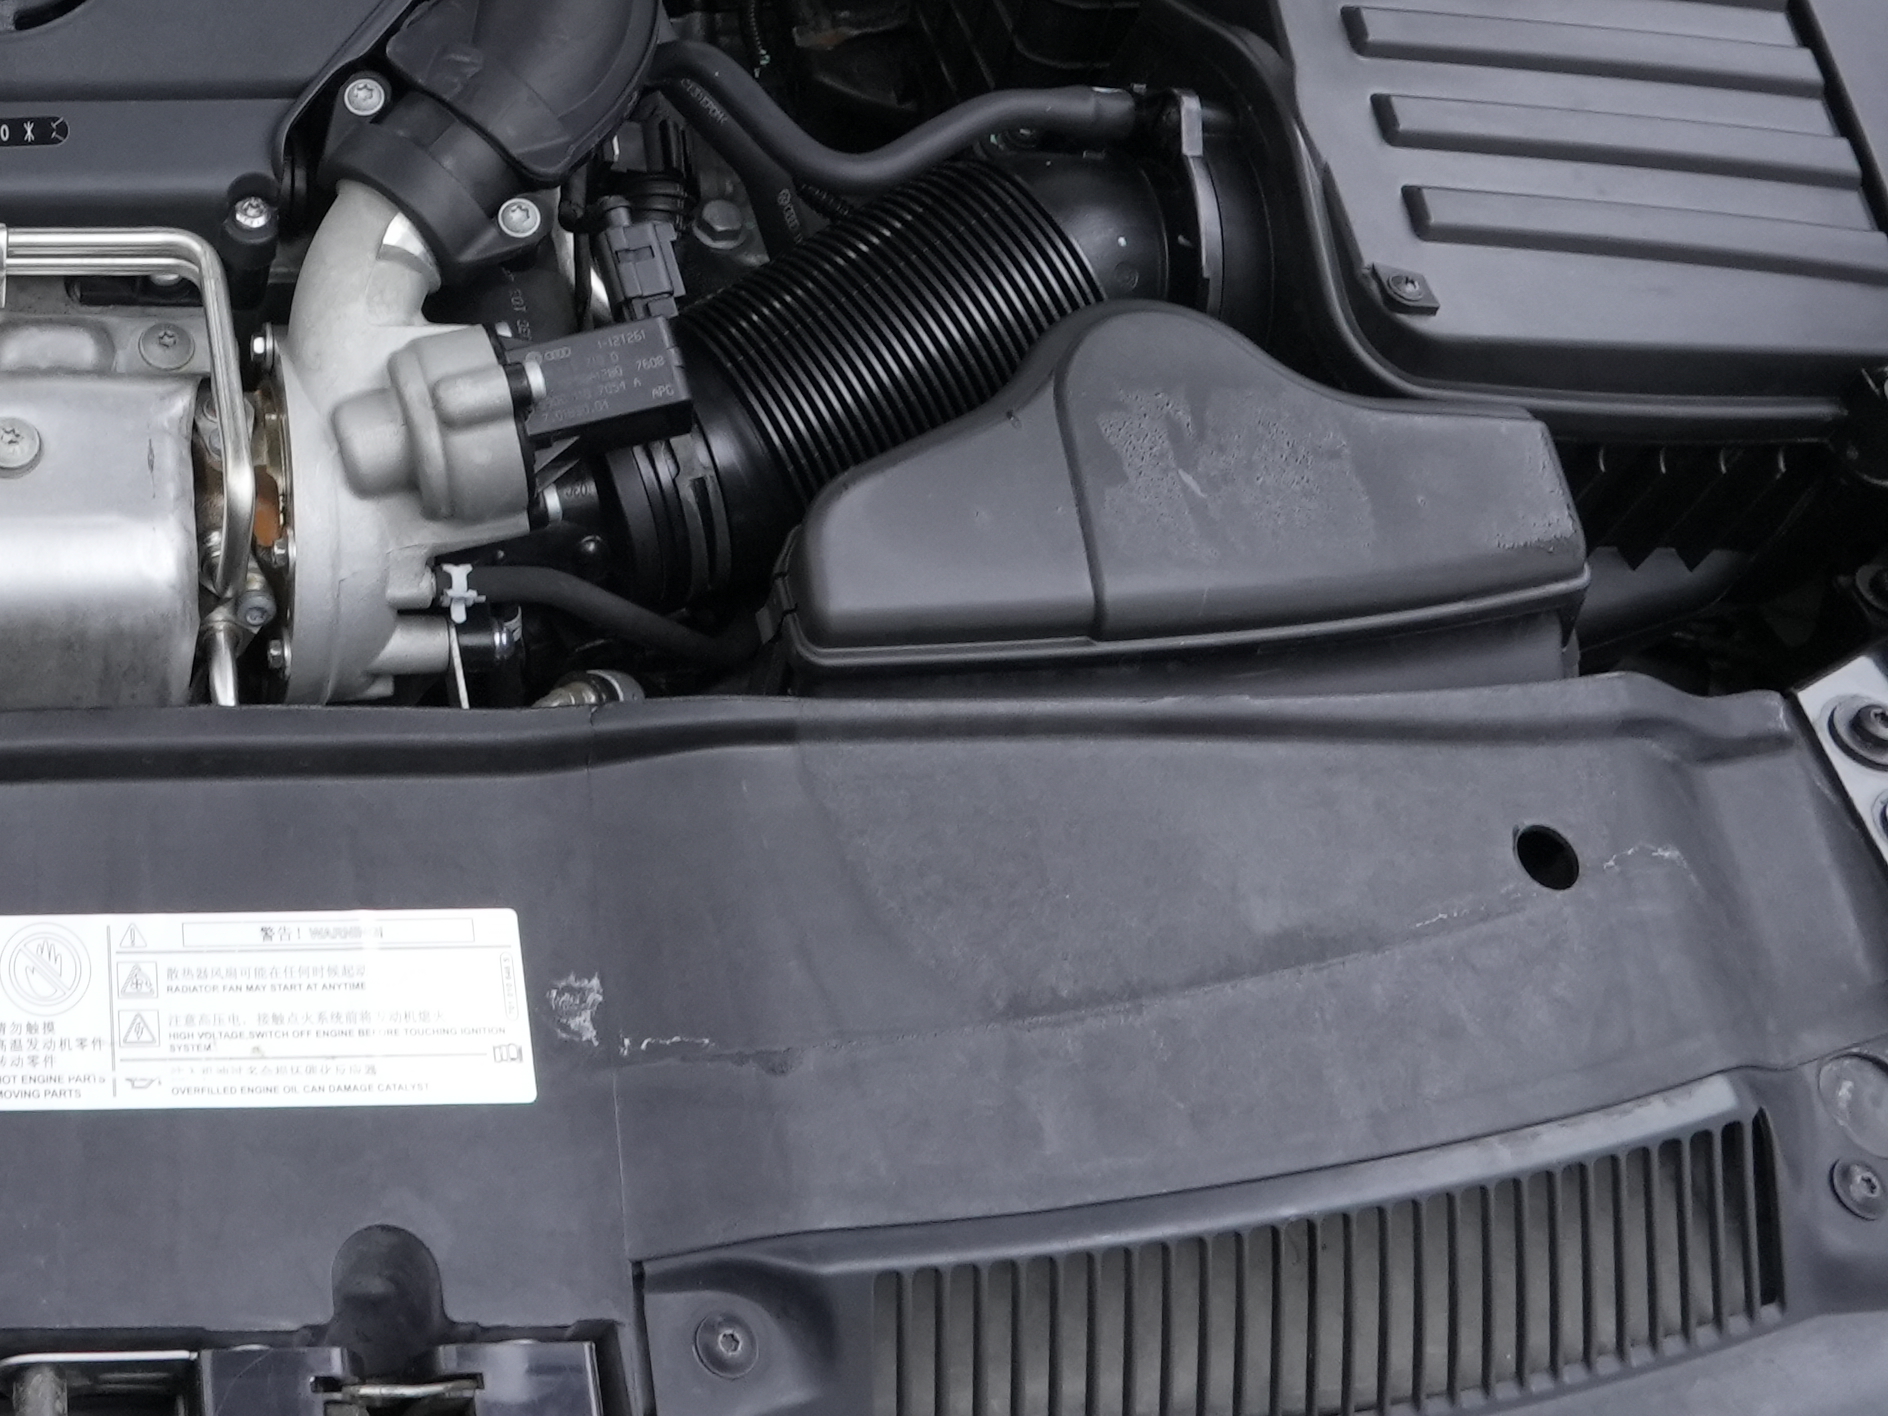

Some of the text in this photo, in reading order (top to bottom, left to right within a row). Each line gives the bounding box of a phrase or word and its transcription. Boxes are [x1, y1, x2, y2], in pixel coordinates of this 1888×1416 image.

[167, 982, 366, 994] RADIATOR FAN MAY START AT ANYTIME
[168, 1031, 195, 1041] HIGH
[292, 1029, 311, 1039] OFF
[315, 1029, 354, 1039] ENGINE
[403, 1028, 457, 1037] TOUCHING
[460, 1027, 506, 1036] IGNITION
[170, 1044, 212, 1053] SYSTEM
[21, 1074, 62, 1084] ENGINE
[44, 1089, 82, 1099] PARTS
[171, 1083, 429, 1096] OVERFILLED ENGINE OIL CAN DAMAGE CATALYST
